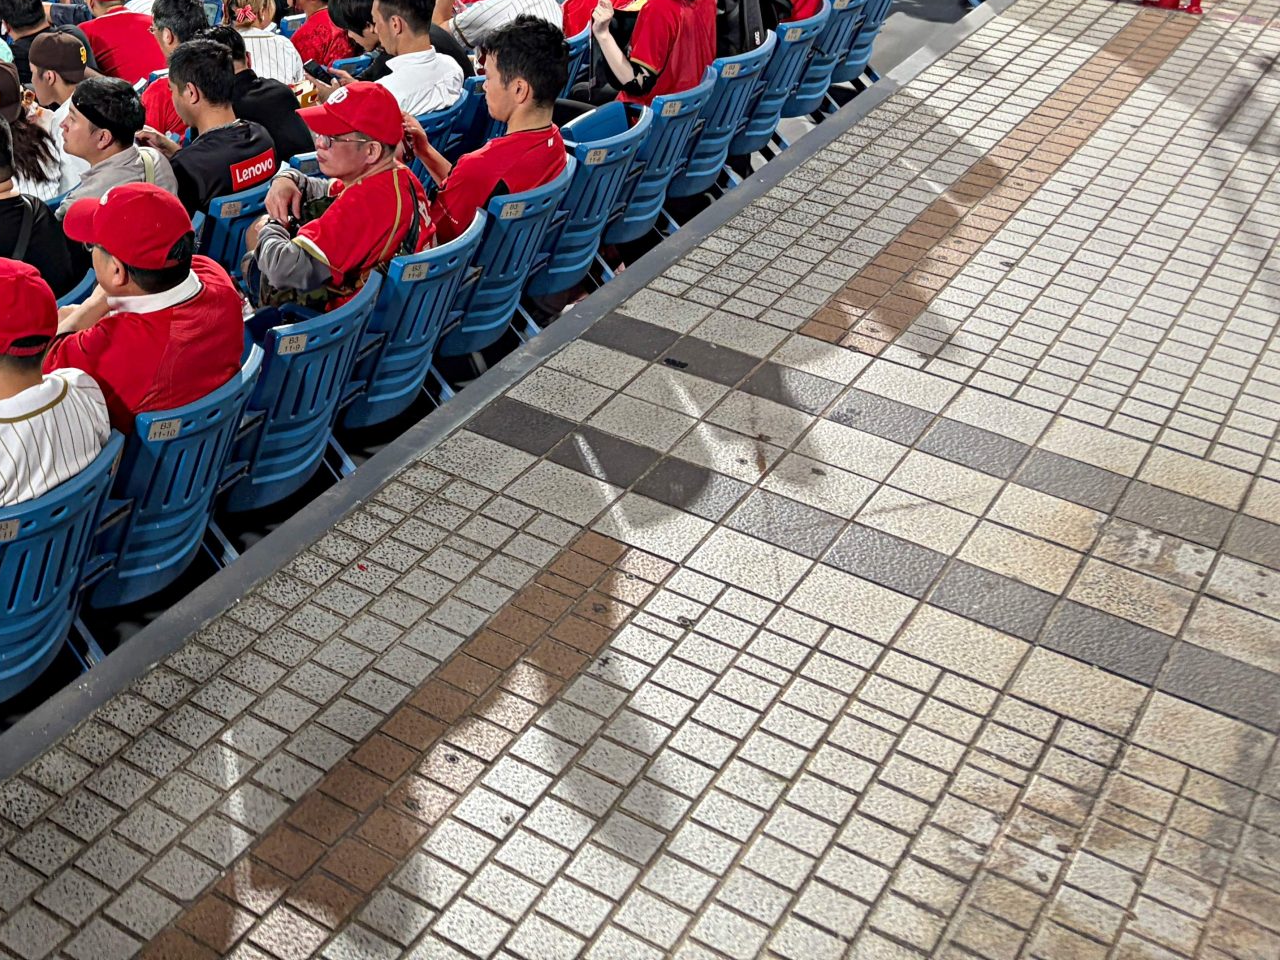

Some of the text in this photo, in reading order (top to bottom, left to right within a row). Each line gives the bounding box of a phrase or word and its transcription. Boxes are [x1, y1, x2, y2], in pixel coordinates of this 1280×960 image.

[234, 157, 274, 184] Lenovo
[288, 336, 299, 345] B3
[283, 343, 302, 352] 11-9
[160, 420, 172, 430] B3
[152, 429, 176, 439] 11-10
